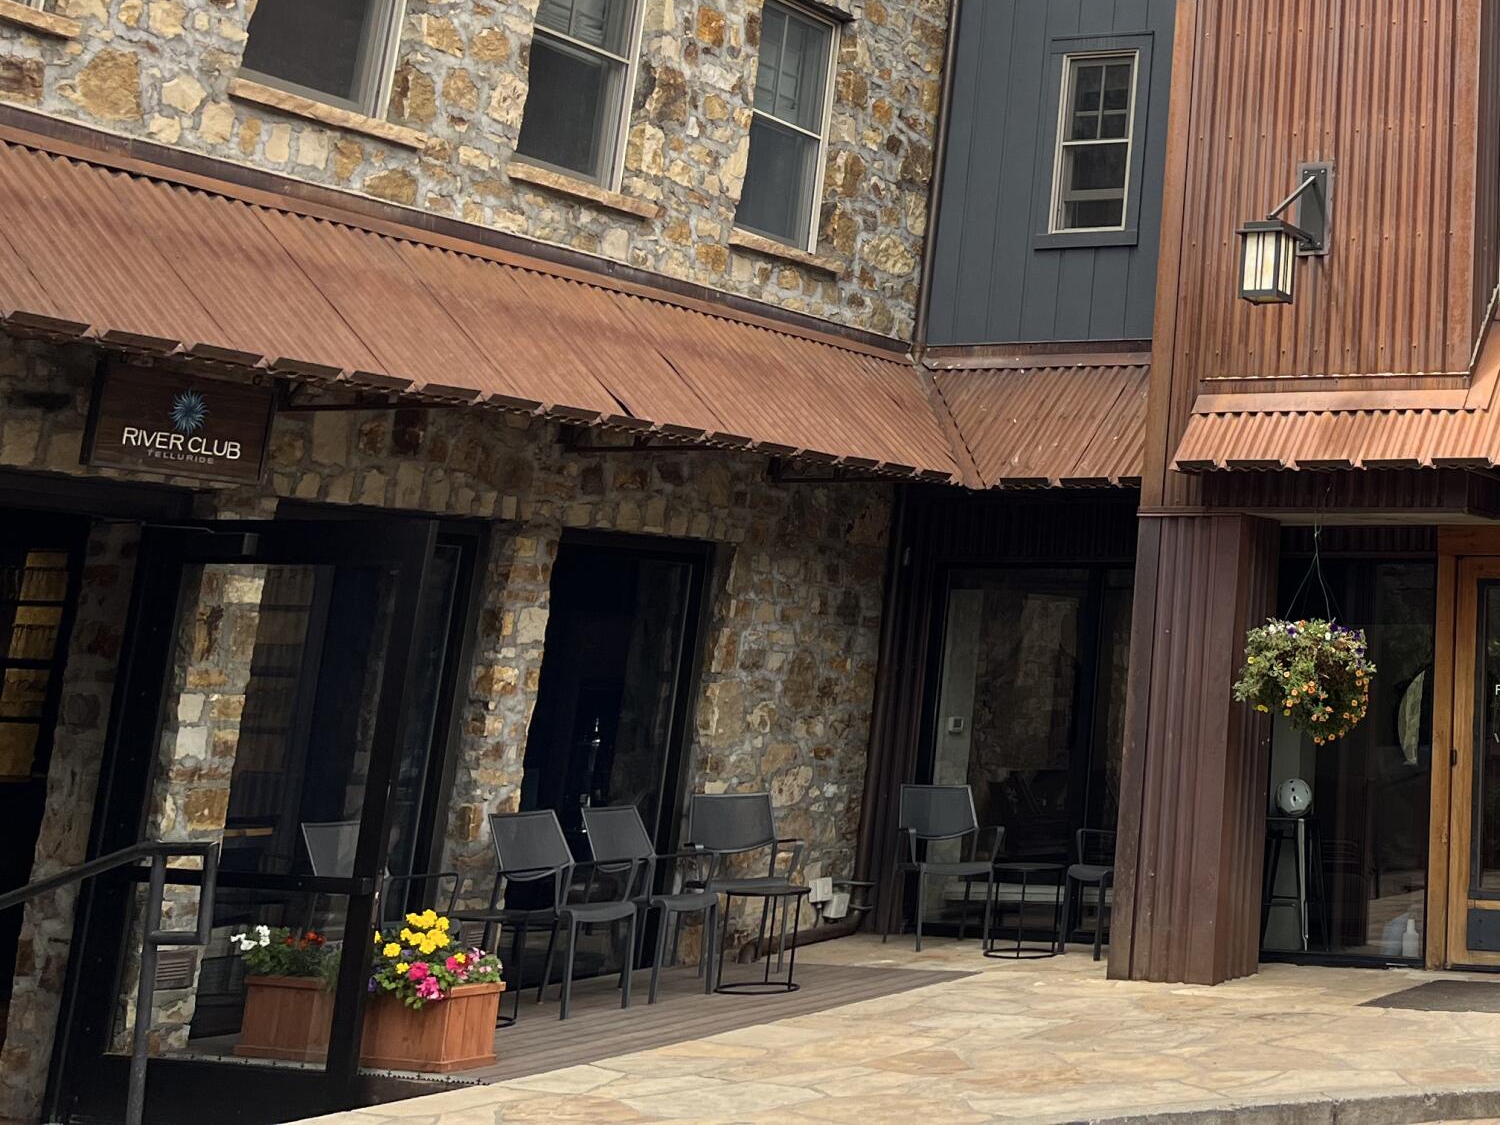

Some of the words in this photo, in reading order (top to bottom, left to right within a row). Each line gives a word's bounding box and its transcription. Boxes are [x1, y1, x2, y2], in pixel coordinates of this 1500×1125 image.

[122, 427, 184, 450] RIVER
[188, 437, 241, 459] CLUB
[147, 449, 214, 464] TELLURIDE
